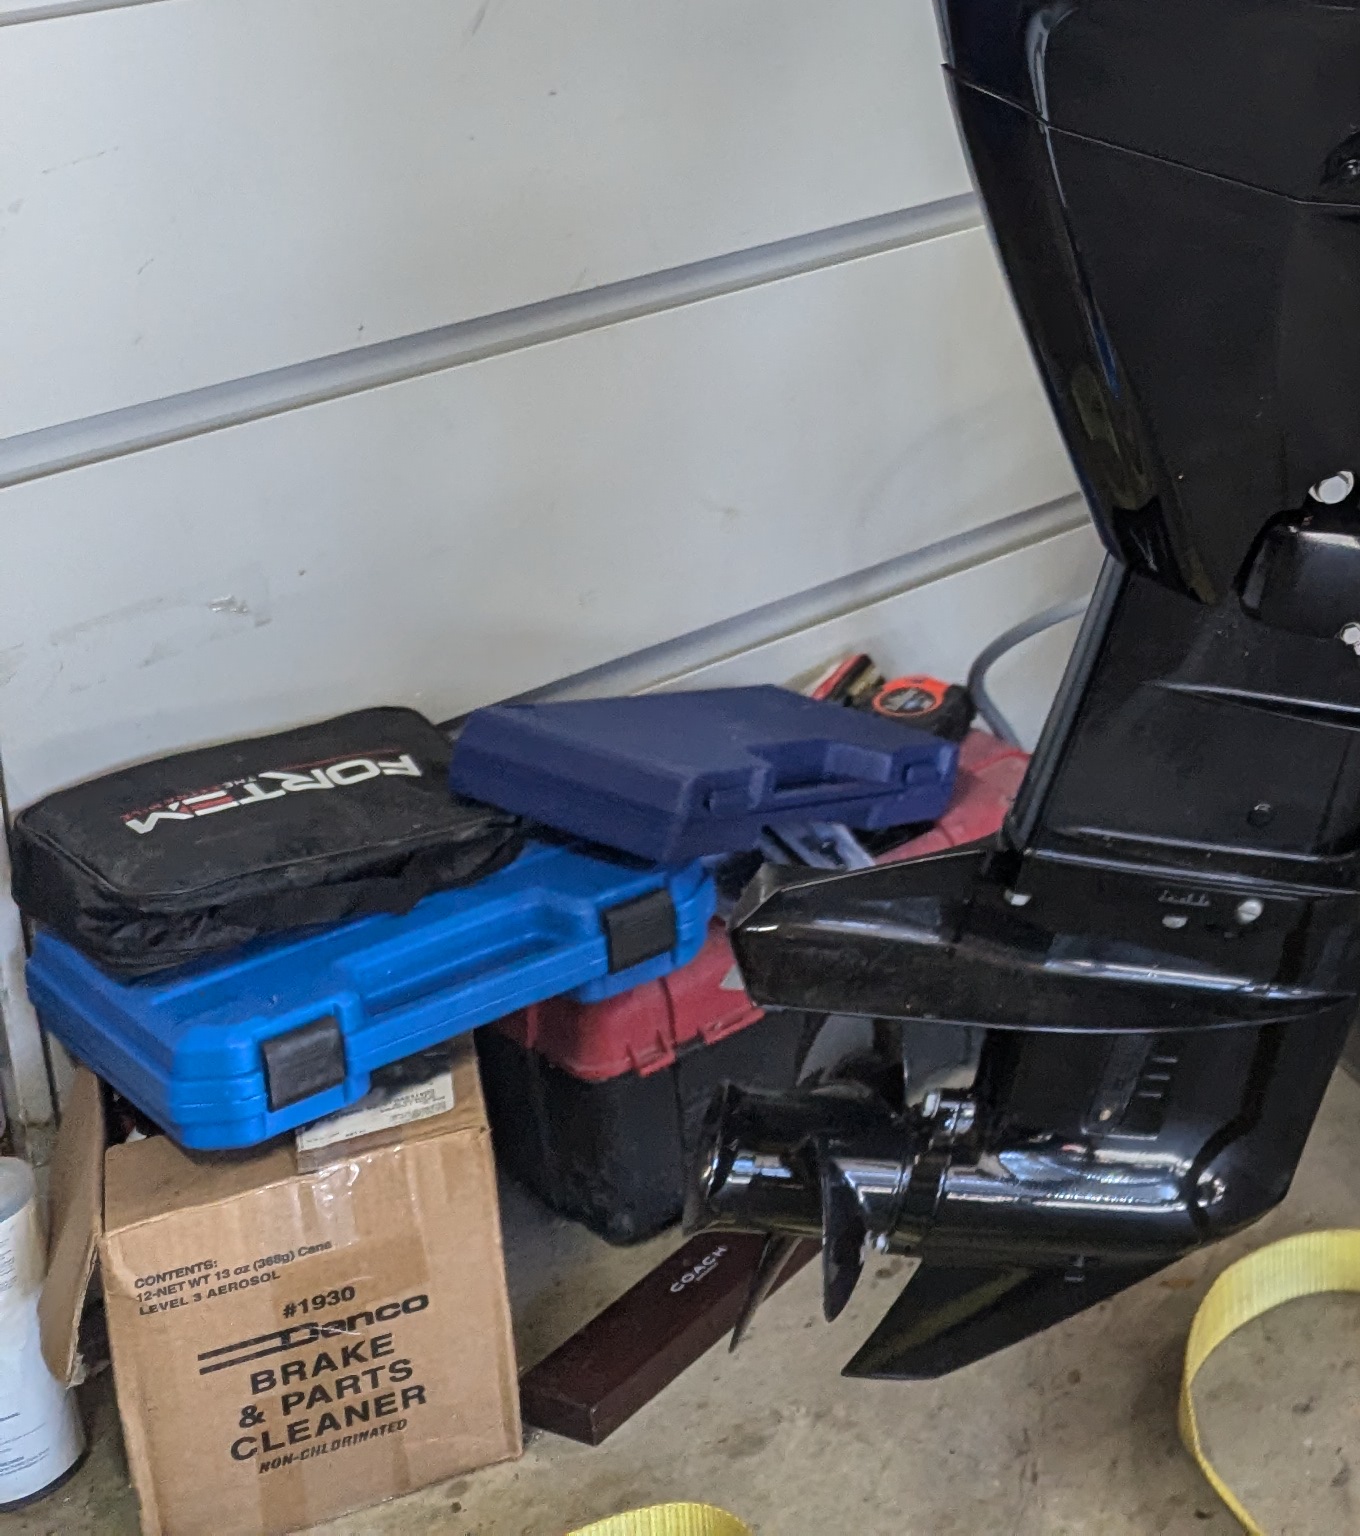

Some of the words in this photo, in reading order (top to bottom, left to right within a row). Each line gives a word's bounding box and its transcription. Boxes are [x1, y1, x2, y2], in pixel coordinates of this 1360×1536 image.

[126, 754, 422, 835] FORTEM
[135, 1259, 218, 1289] CONTENTS:
[137, 1281, 186, 1302] 12-NET
[188, 1274, 211, 1289] WT
[214, 1269, 231, 1281] 13
[233, 1265, 251, 1275] oz
[253, 1250, 296, 1272] (368g)
[139, 1297, 189, 1315] LEVEL
[193, 1293, 202, 1302] 3
[207, 1270, 281, 1299] AEROSOL
[670, 1245, 727, 1293] COACH
[283, 1286, 356, 1319] #1930
[250, 1333, 395, 1395] BRAKE
[239, 1404, 266, 1428] &
[281, 1359, 413, 1416] PARTS
[230, 1384, 427, 1461] CLEANER
[258, 1418, 408, 1474] NON-CHLORINATED
